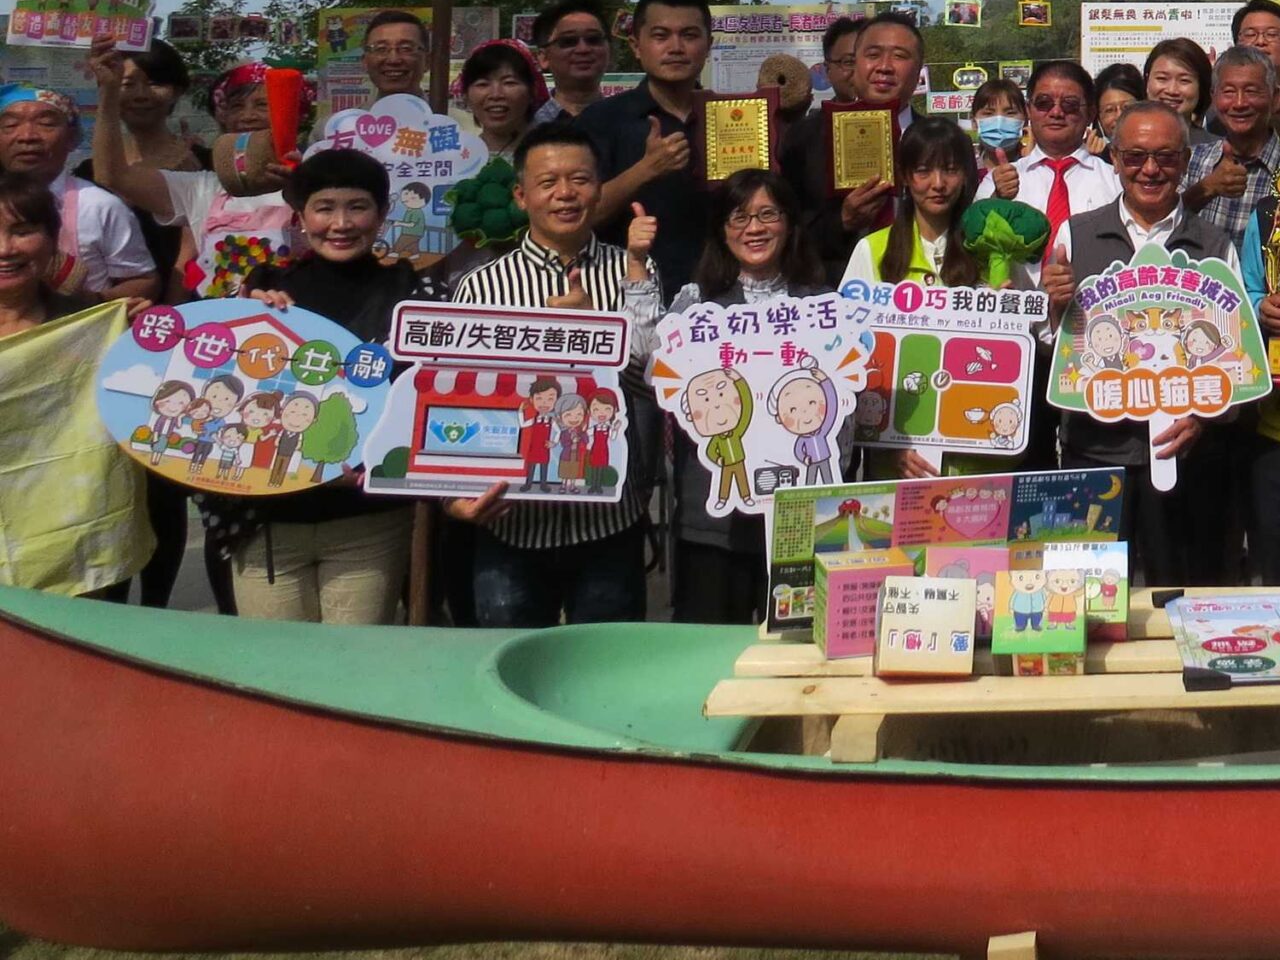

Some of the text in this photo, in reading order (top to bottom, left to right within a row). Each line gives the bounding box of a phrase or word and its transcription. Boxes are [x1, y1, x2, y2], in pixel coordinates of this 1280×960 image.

[359, 124, 392, 136] LOVE
[1077, 266, 1242, 314] 我的高齡友善城市
[1104, 294, 1136, 312] Miaoli
[1166, 292, 1208, 311] Friendly
[404, 319, 617, 356] 高齡/失智友善商店
[688, 299, 838, 344] 爺奶樂活
[937, 317, 1024, 331] my meal plate
[138, 312, 387, 381] 跨世代共融
[718, 341, 810, 368] 動一動
